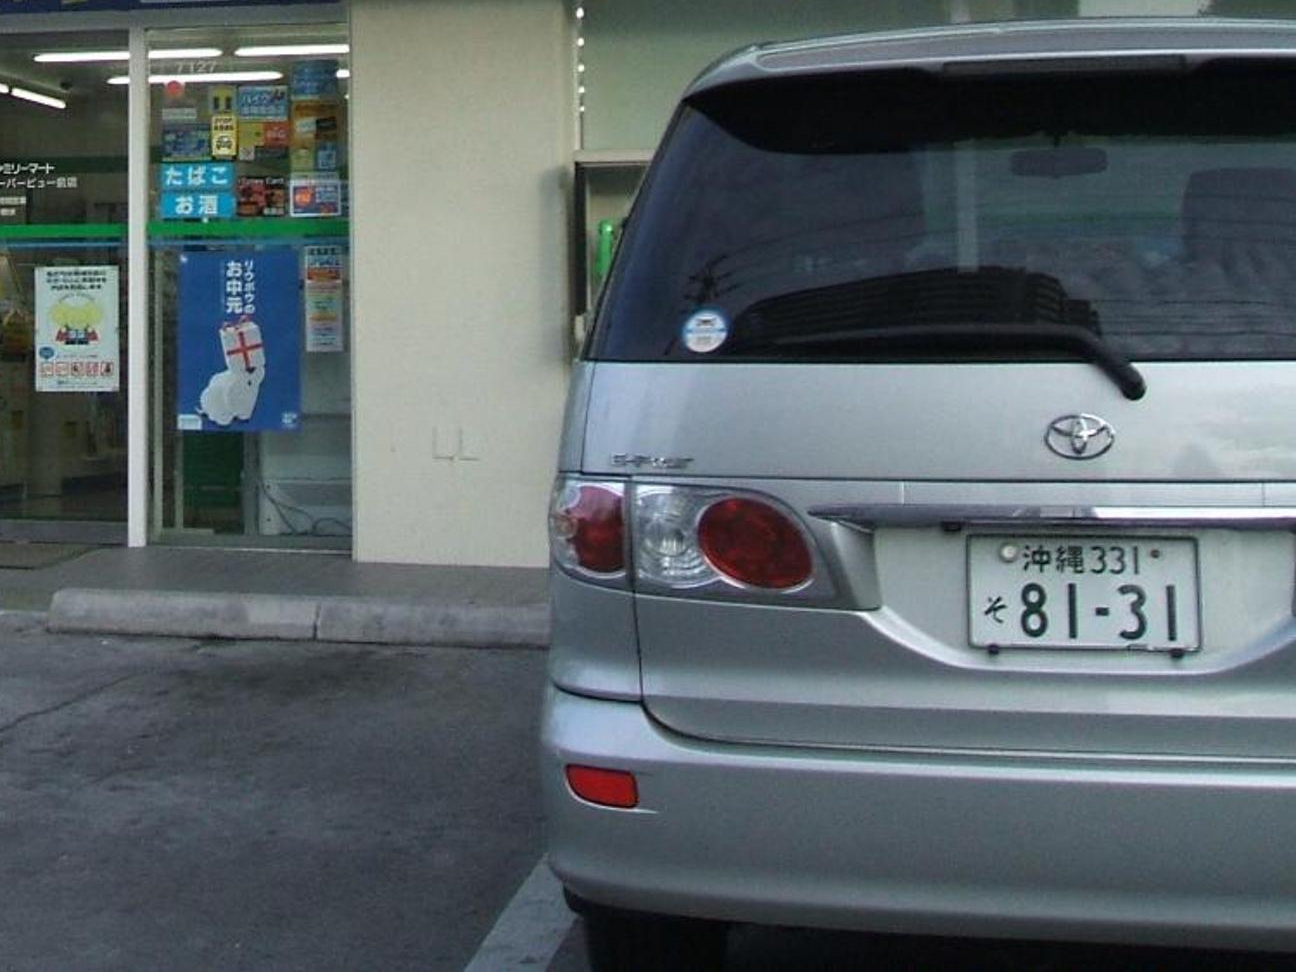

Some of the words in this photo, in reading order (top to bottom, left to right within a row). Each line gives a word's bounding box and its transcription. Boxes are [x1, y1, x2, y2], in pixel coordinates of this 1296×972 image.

[164, 164, 230, 186] たばこ
[174, 194, 218, 216] お酒
[225, 259, 243, 315] お中元
[244, 259, 256, 315] リウボウの
[1022, 545, 1084, 574] 沖縄
[1090, 545, 1140, 575] 331
[984, 595, 1007, 624] そ
[1020, 582, 1177, 642] 81-31
